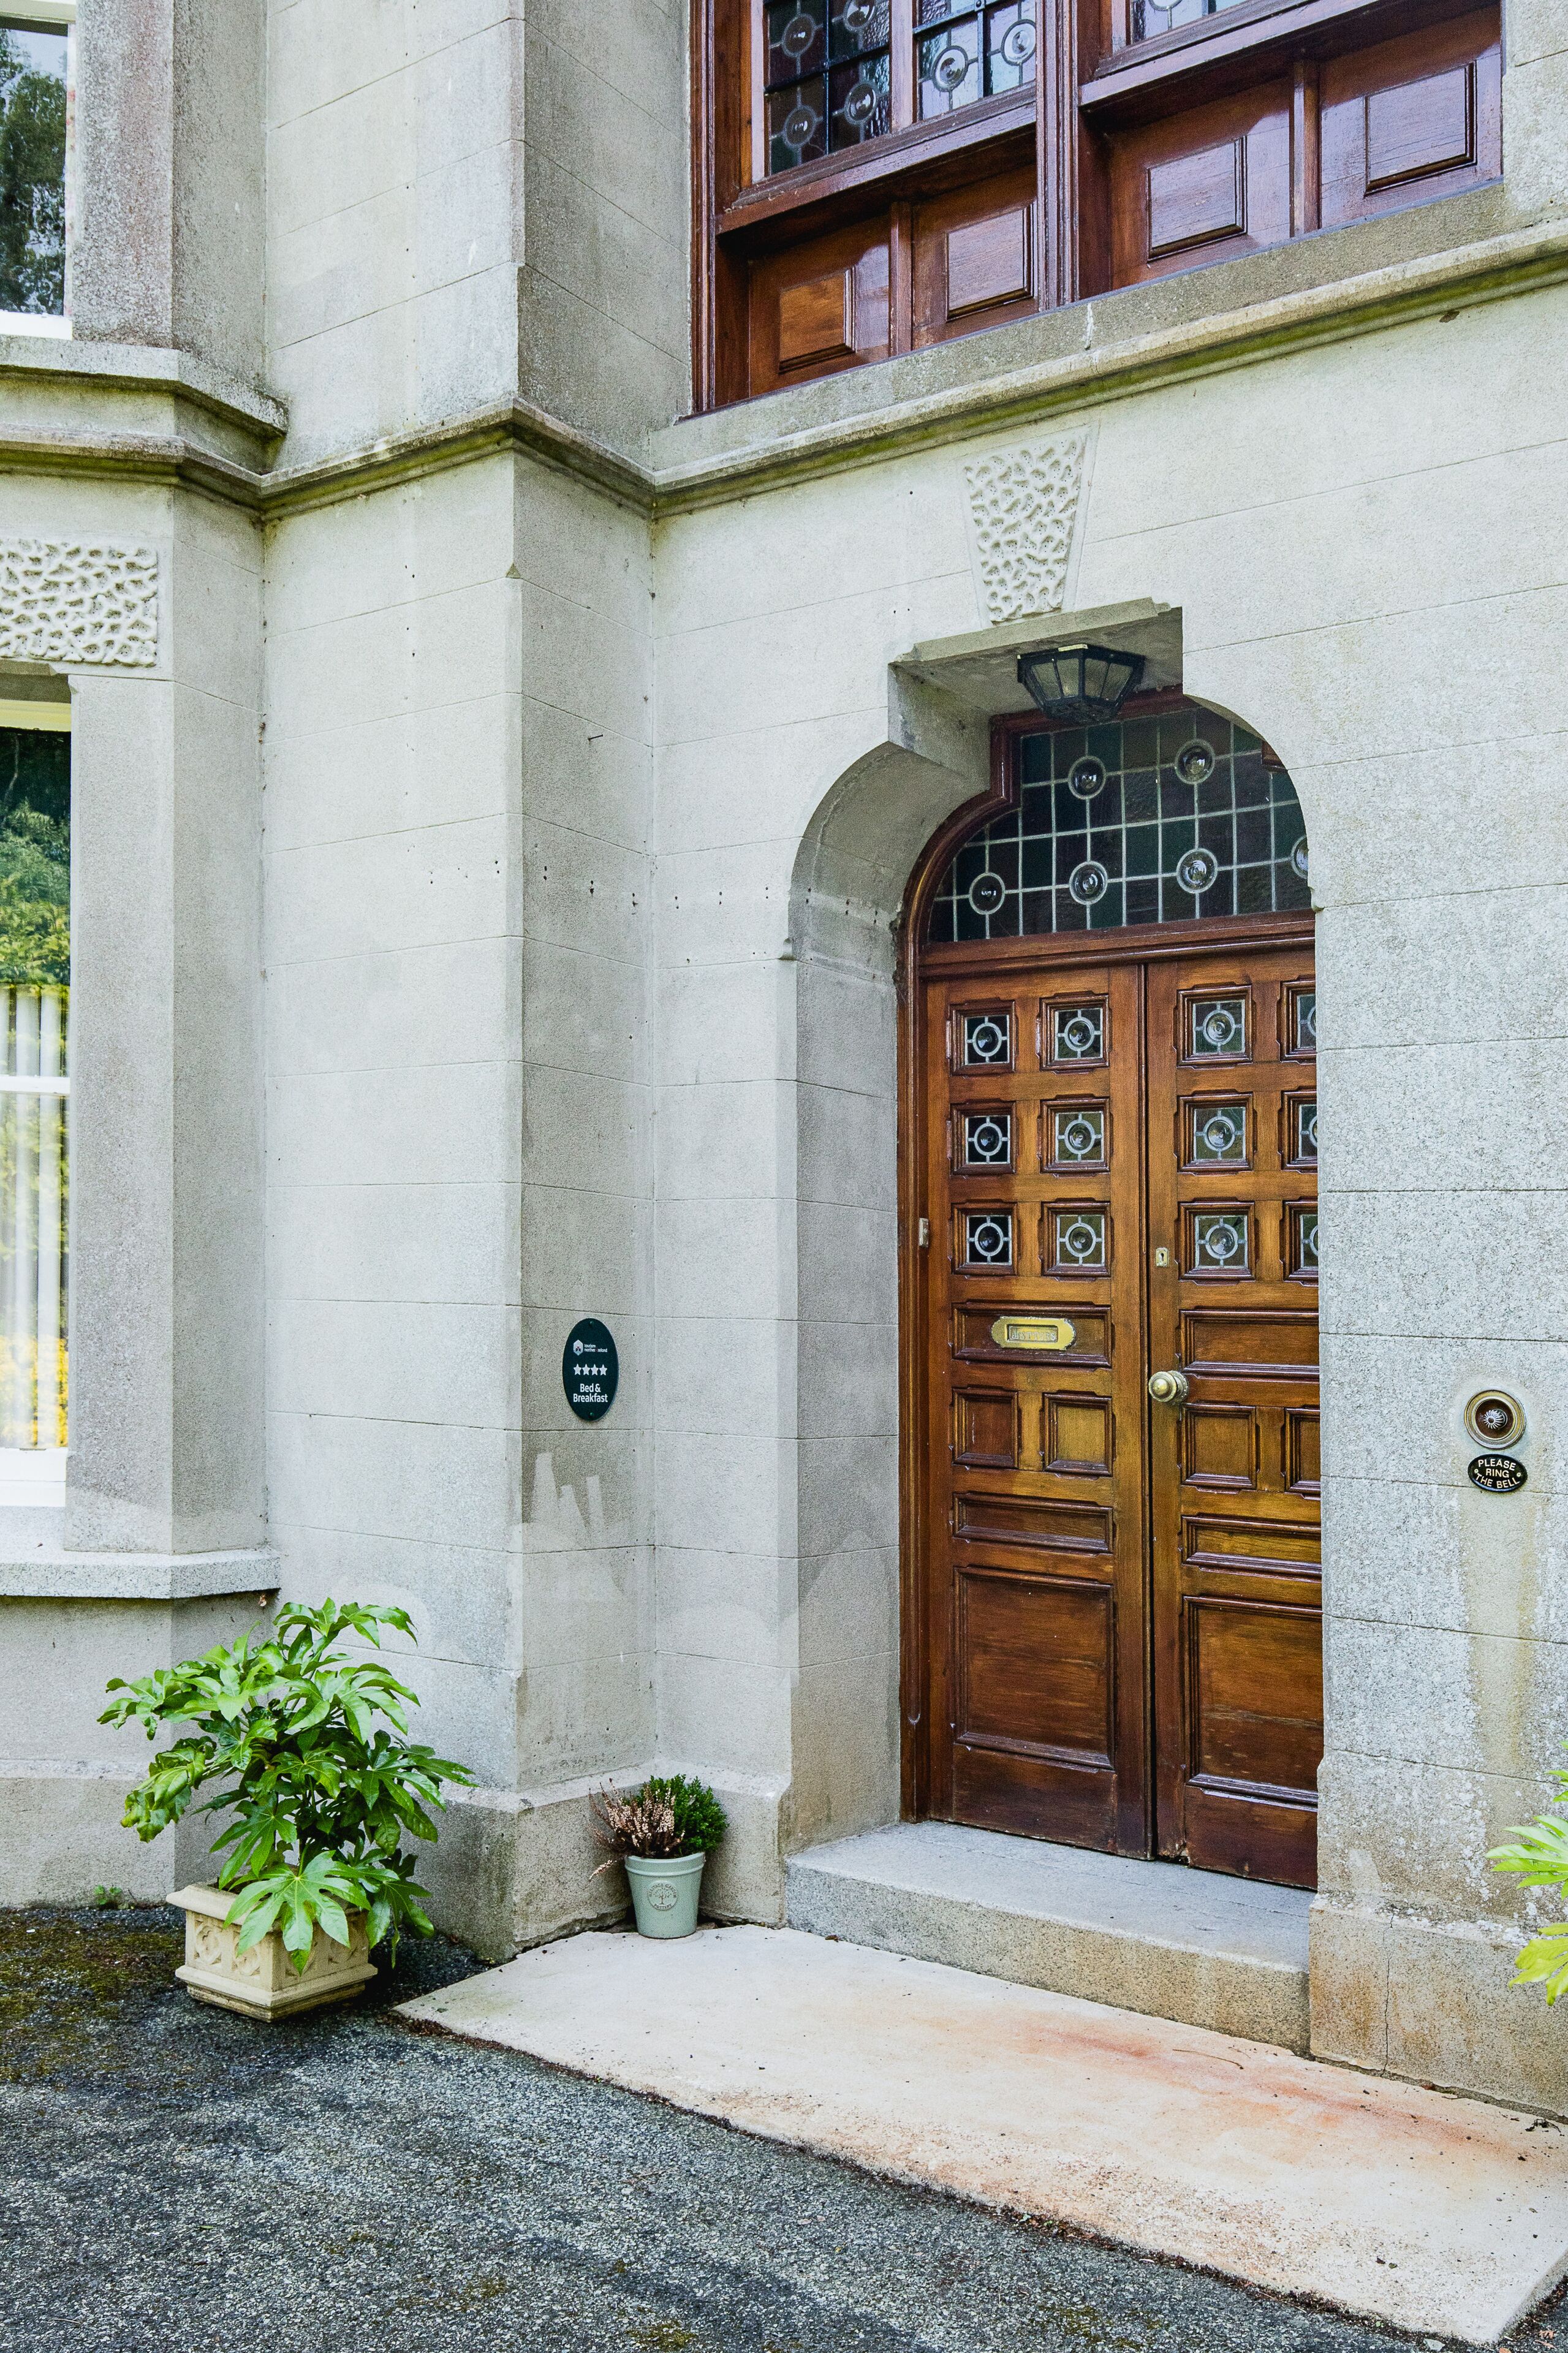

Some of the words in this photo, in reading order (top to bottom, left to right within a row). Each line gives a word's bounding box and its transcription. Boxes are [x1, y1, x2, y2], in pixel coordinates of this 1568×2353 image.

[580, 1384, 594, 1392] Bed
[595, 1384, 601, 1392] &
[573, 1393, 608, 1403] Breakfast
[1478, 1458, 1517, 1471] PLEASE
[1486, 1468, 1509, 1478] RING
[1475, 1473, 1493, 1487] THE
[1496, 1477, 1520, 1488] BELL
